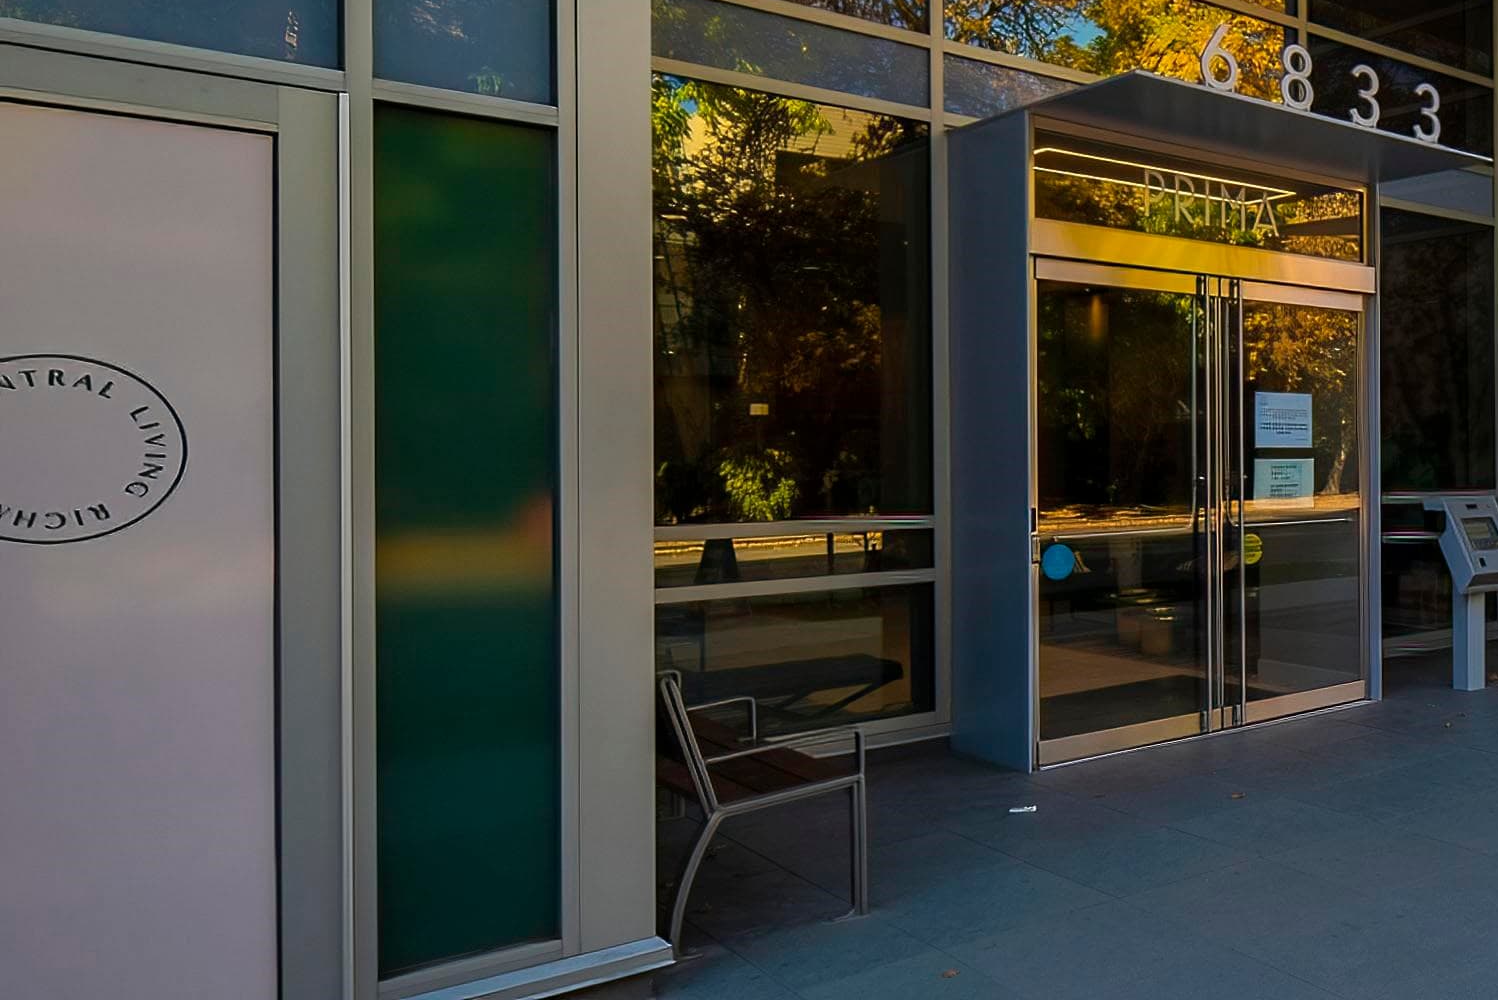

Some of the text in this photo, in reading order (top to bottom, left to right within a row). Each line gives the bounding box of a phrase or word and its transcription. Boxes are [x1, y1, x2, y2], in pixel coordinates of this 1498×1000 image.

[1201, 23, 1441, 143] 6833
[1144, 169, 1279, 237] PRIMA
[125, 405, 167, 498] LIVING
